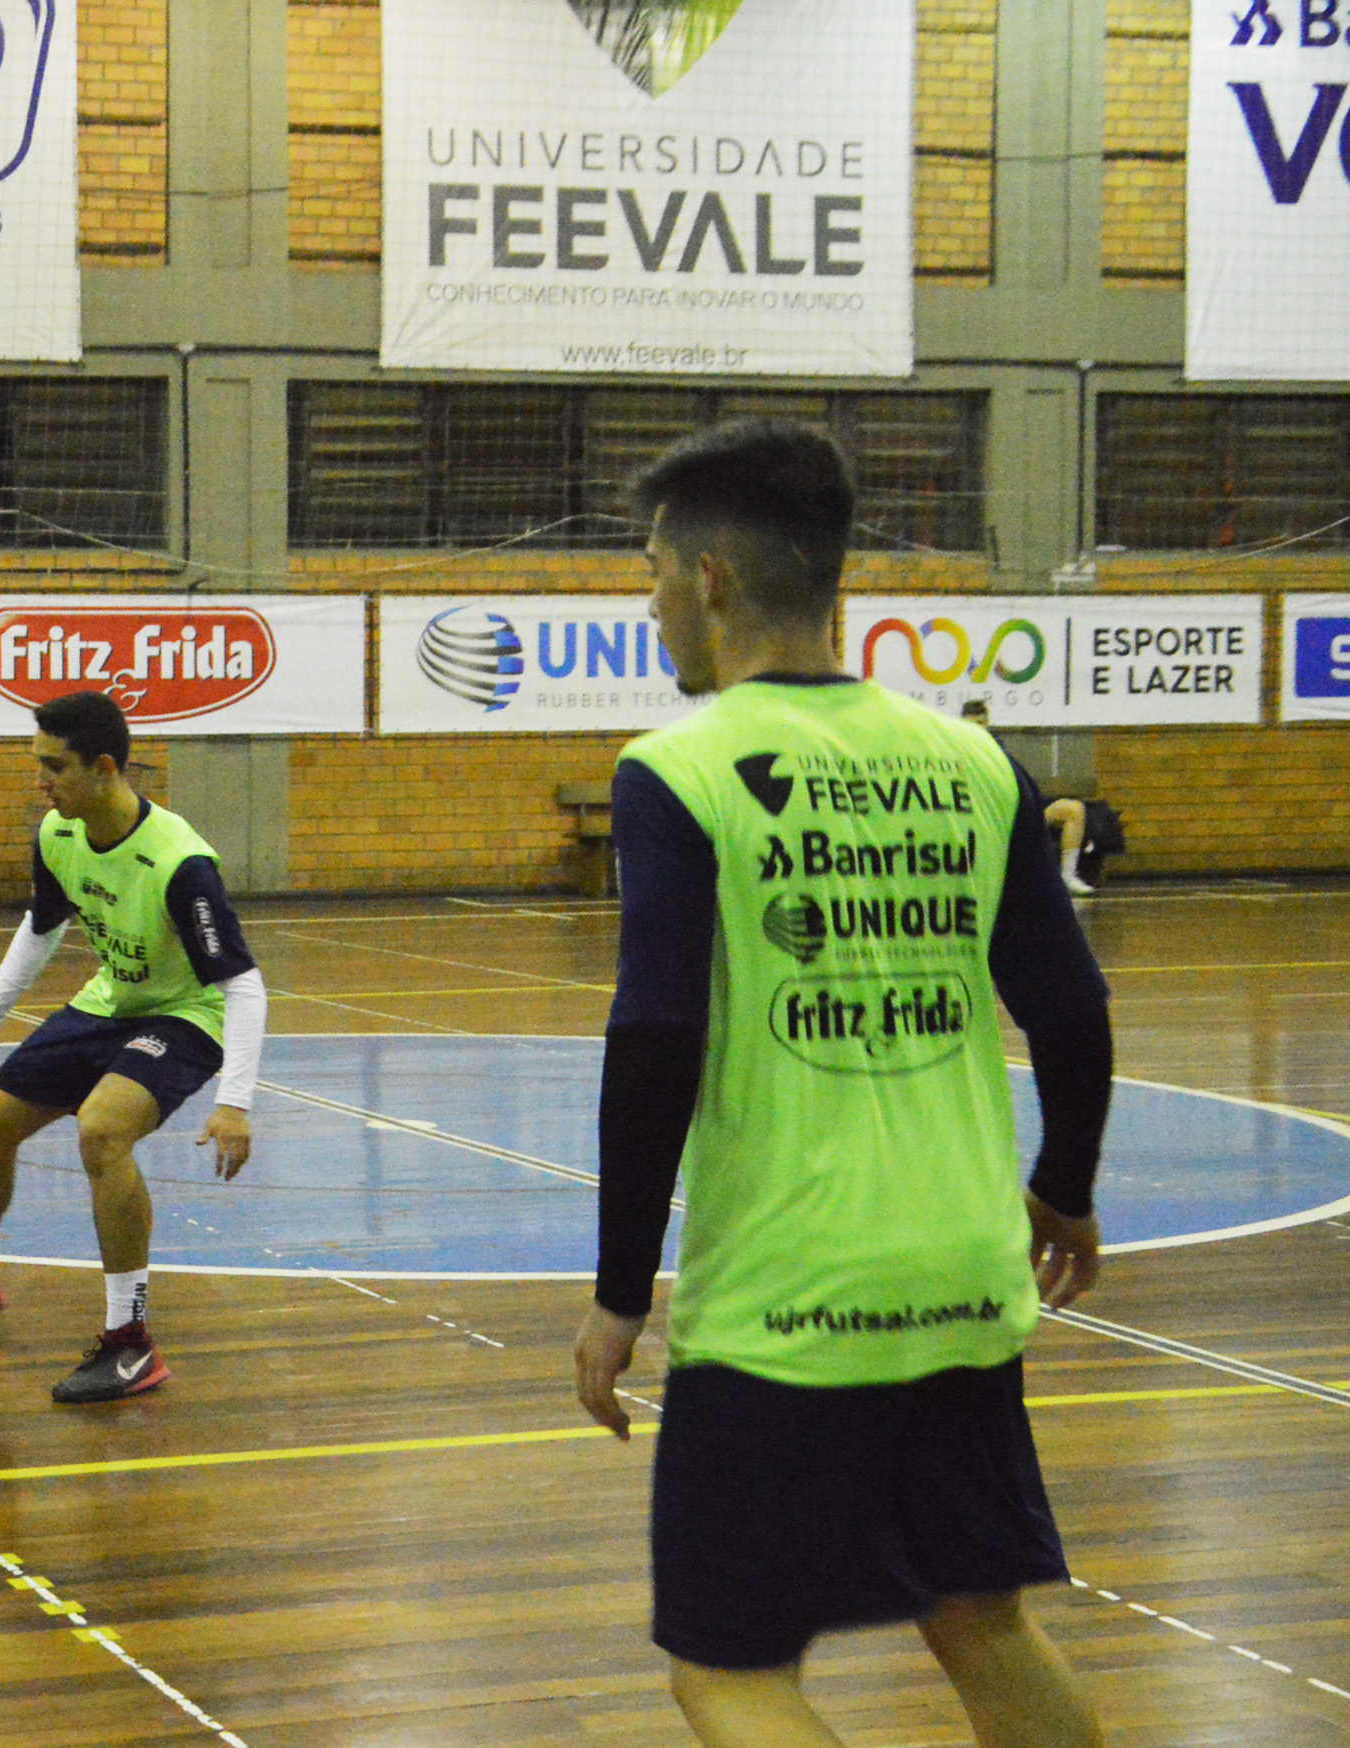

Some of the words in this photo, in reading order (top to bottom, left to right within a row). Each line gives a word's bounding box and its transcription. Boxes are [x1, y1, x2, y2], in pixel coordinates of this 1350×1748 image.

[427, 127, 865, 179] UNIVERSIDADE
[427, 182, 866, 277] FEEVALE
[427, 282, 607, 307] CONHECIMENTO
[616, 288, 670, 308] PARA
[677, 289, 755, 310] INOVAR
[757, 292, 777, 311] O
[782, 292, 865, 312] MUNDO
[561, 342, 749, 367] www.feevale.br
[538, 621, 676, 678] UNI
[1094, 627, 1244, 657] ESPORTE
[1093, 665, 1112, 695] E
[1128, 664, 1235, 694] LAZER
[537, 692, 622, 708] RUBBER
[805, 776, 973, 814] FEEVALE
[802, 828, 977, 877] Banrisul
[831, 894, 978, 939] UNIQUE
